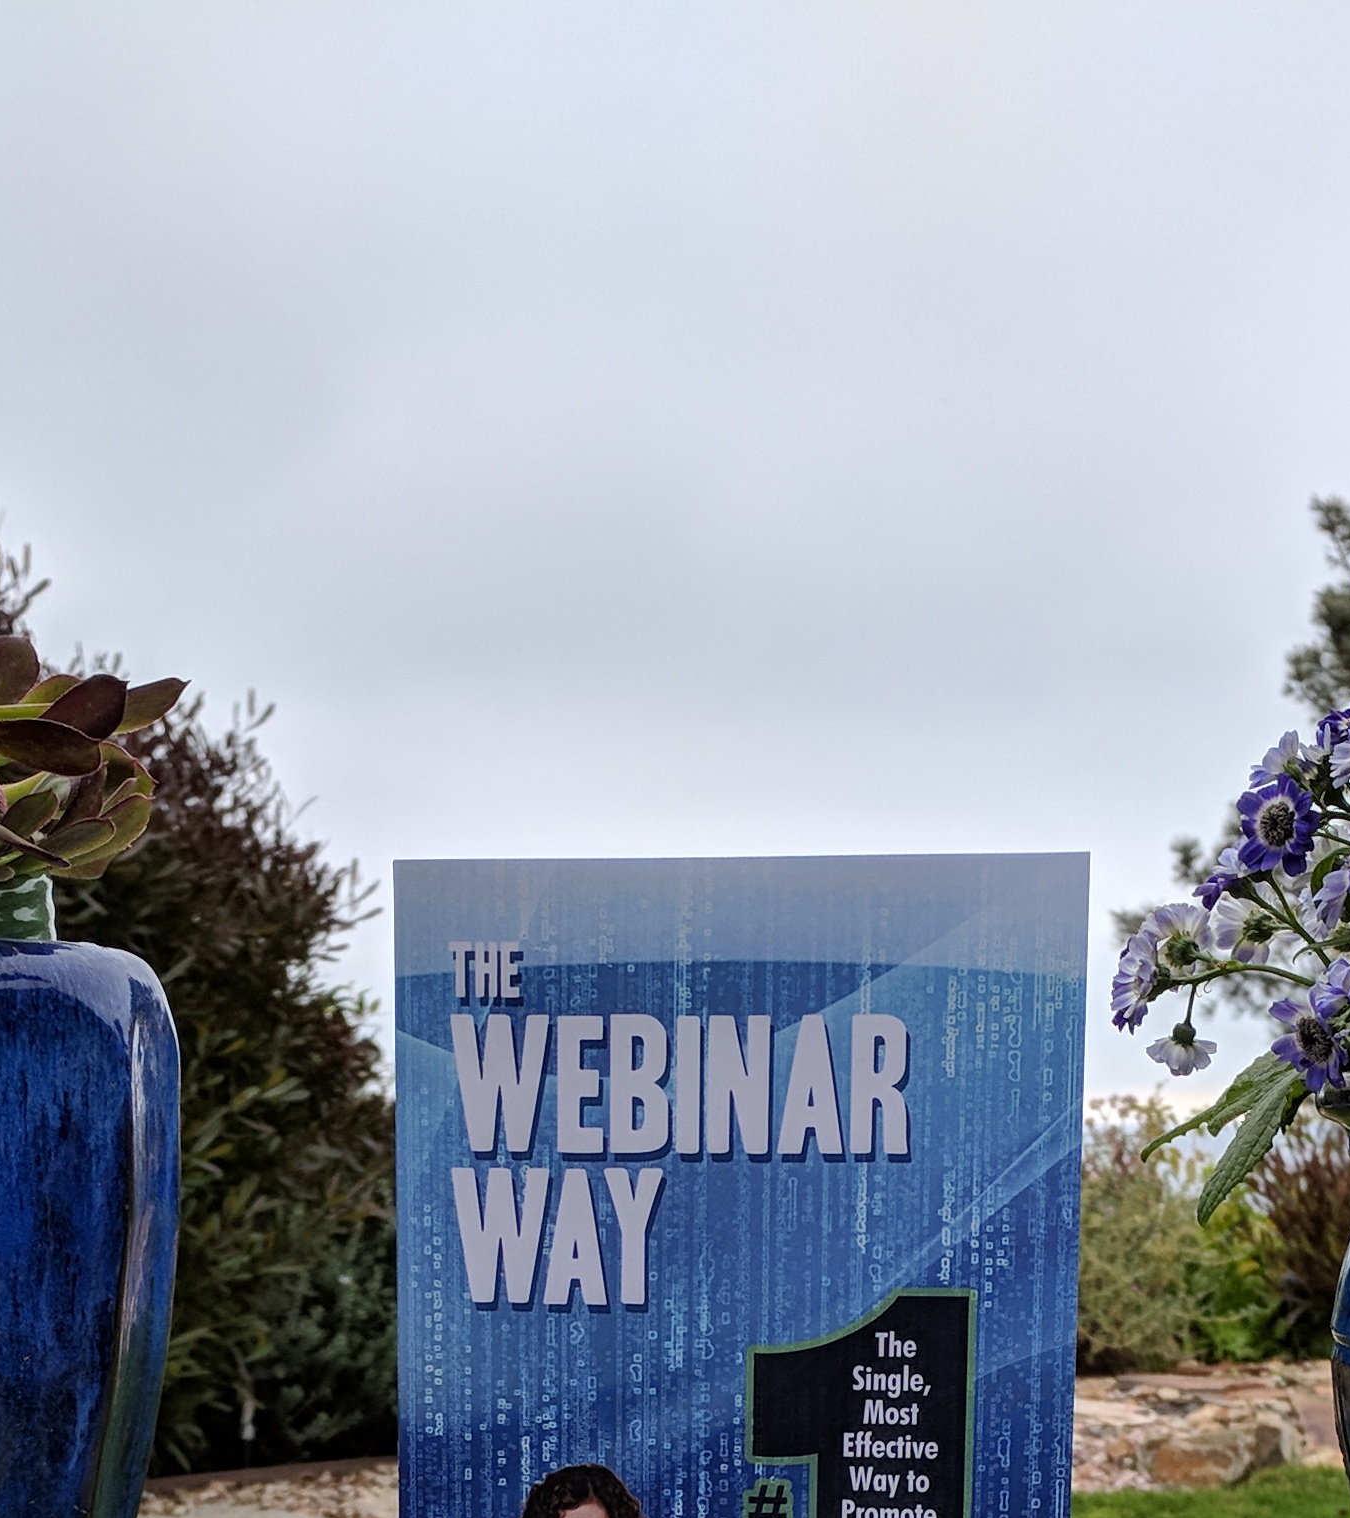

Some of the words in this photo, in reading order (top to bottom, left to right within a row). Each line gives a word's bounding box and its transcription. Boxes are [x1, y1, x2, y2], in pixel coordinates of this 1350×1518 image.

[451, 942, 522, 998] THE
[452, 1014, 909, 1155] WEBINAR
[452, 1167, 663, 1306] WAY
[875, 1330, 917, 1358] The
[852, 1364, 932, 1399] Single,
[863, 1399, 920, 1426] Most
[843, 1430, 939, 1460] Effective
[849, 1465, 902, 1498] Way
[907, 1468, 930, 1494] to
